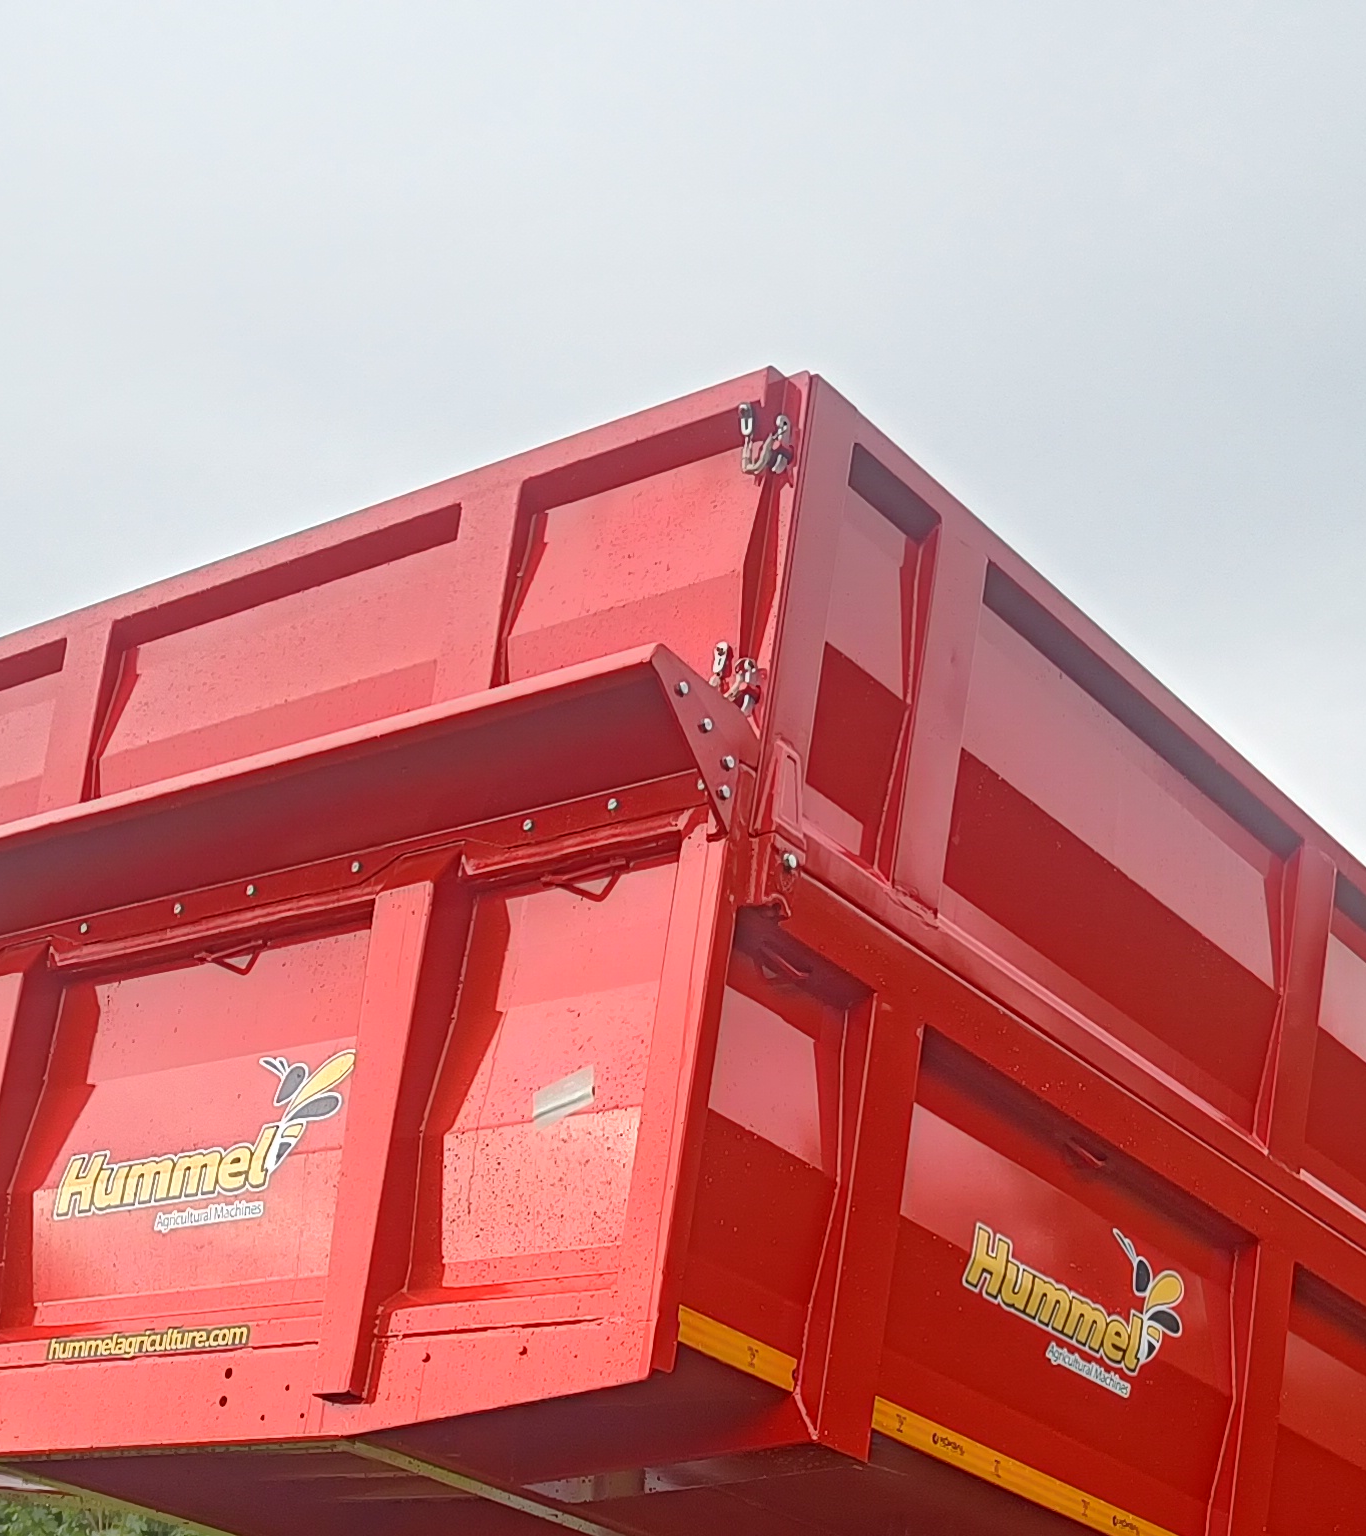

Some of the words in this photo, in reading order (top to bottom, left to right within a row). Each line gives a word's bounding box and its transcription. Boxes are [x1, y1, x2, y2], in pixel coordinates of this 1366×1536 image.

[56, 1123, 278, 1217] Hummel
[156, 1207, 212, 1231] Agricultural
[214, 1203, 262, 1220] Machines
[965, 1225, 1144, 1372] Hummel
[48, 1326, 248, 1359] hummelagriculture.com
[1048, 1344, 1093, 1377] Agricultural
[1093, 1367, 1129, 1396] Machines
